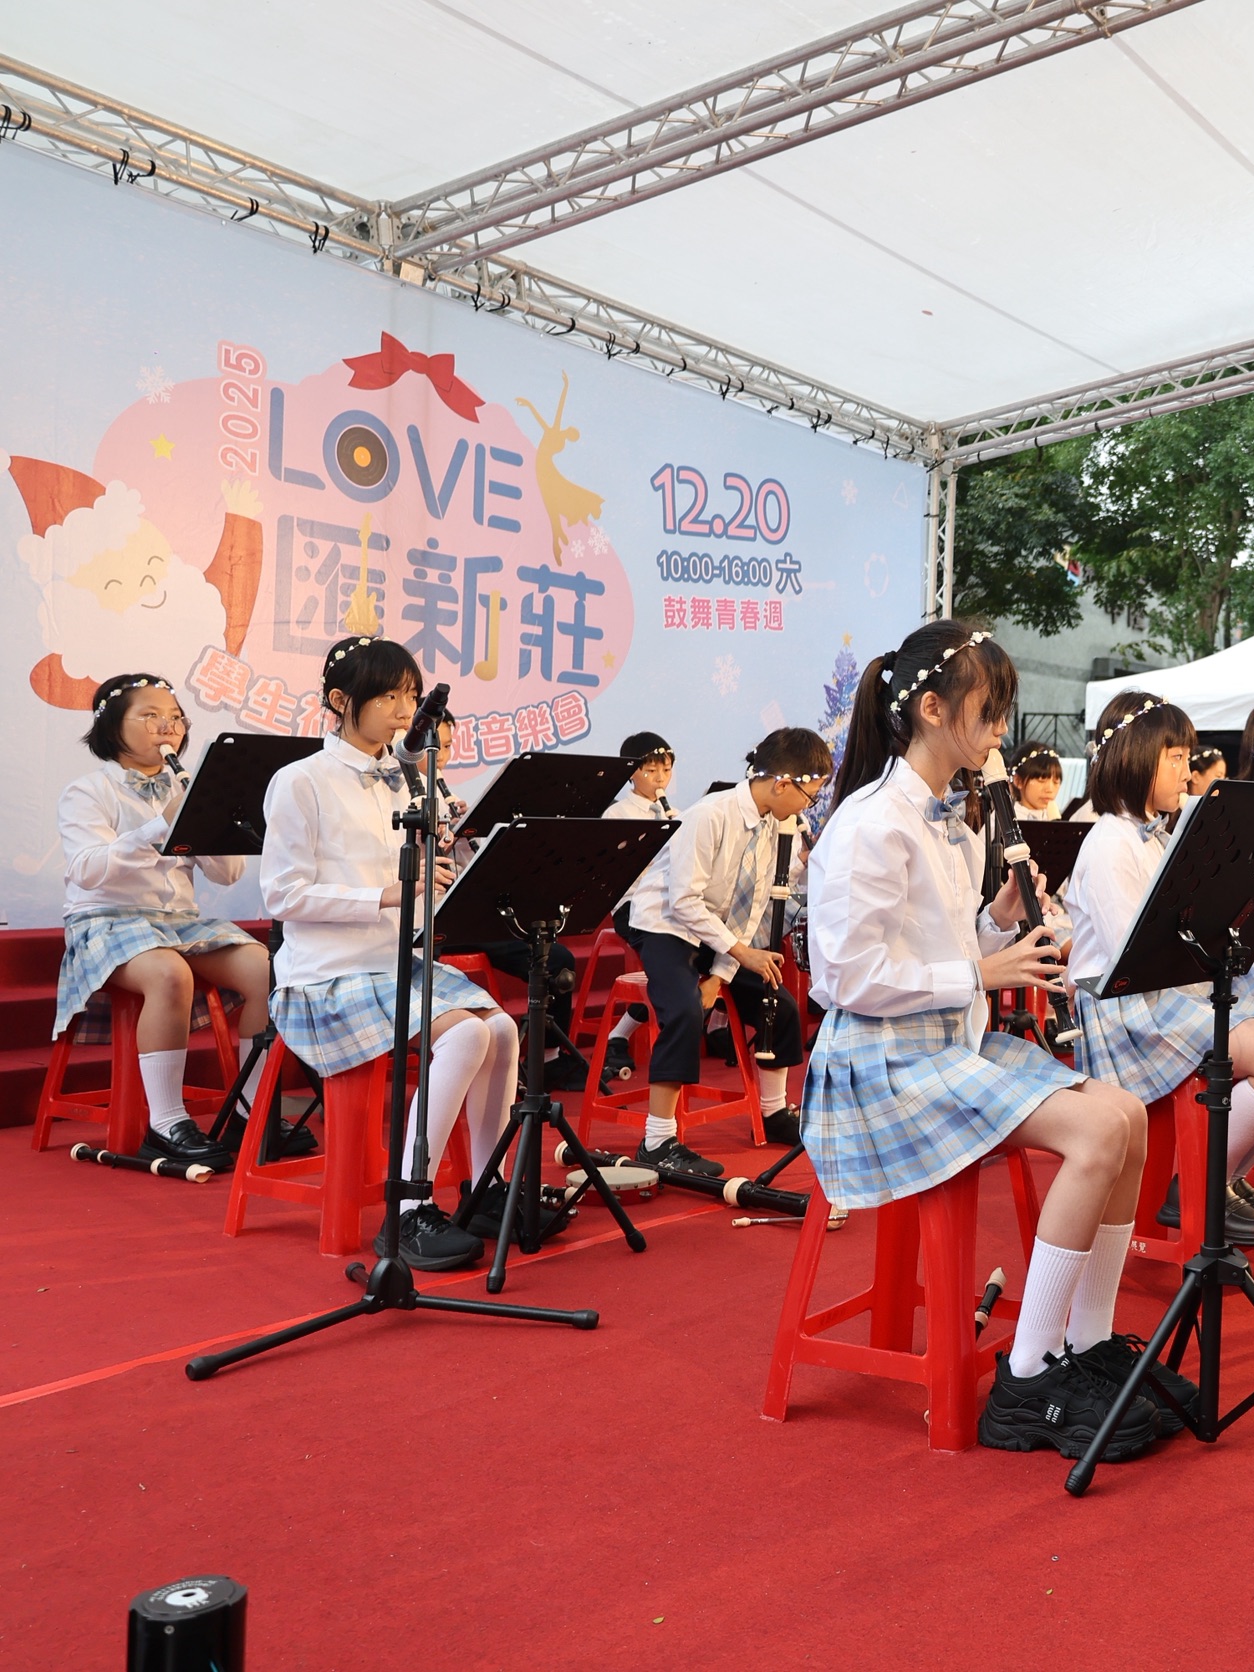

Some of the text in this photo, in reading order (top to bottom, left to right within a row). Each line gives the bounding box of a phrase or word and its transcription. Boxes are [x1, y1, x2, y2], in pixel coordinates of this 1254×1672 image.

[217, 342, 263, 477] 2025
[268, 387, 524, 533] LOVE
[650, 463, 790, 545] 12.20
[273, 514, 606, 687] 匯新莊
[657, 551, 802, 595] 10:00-16:00 六
[664, 596, 784, 631] 鼓舞青春週
